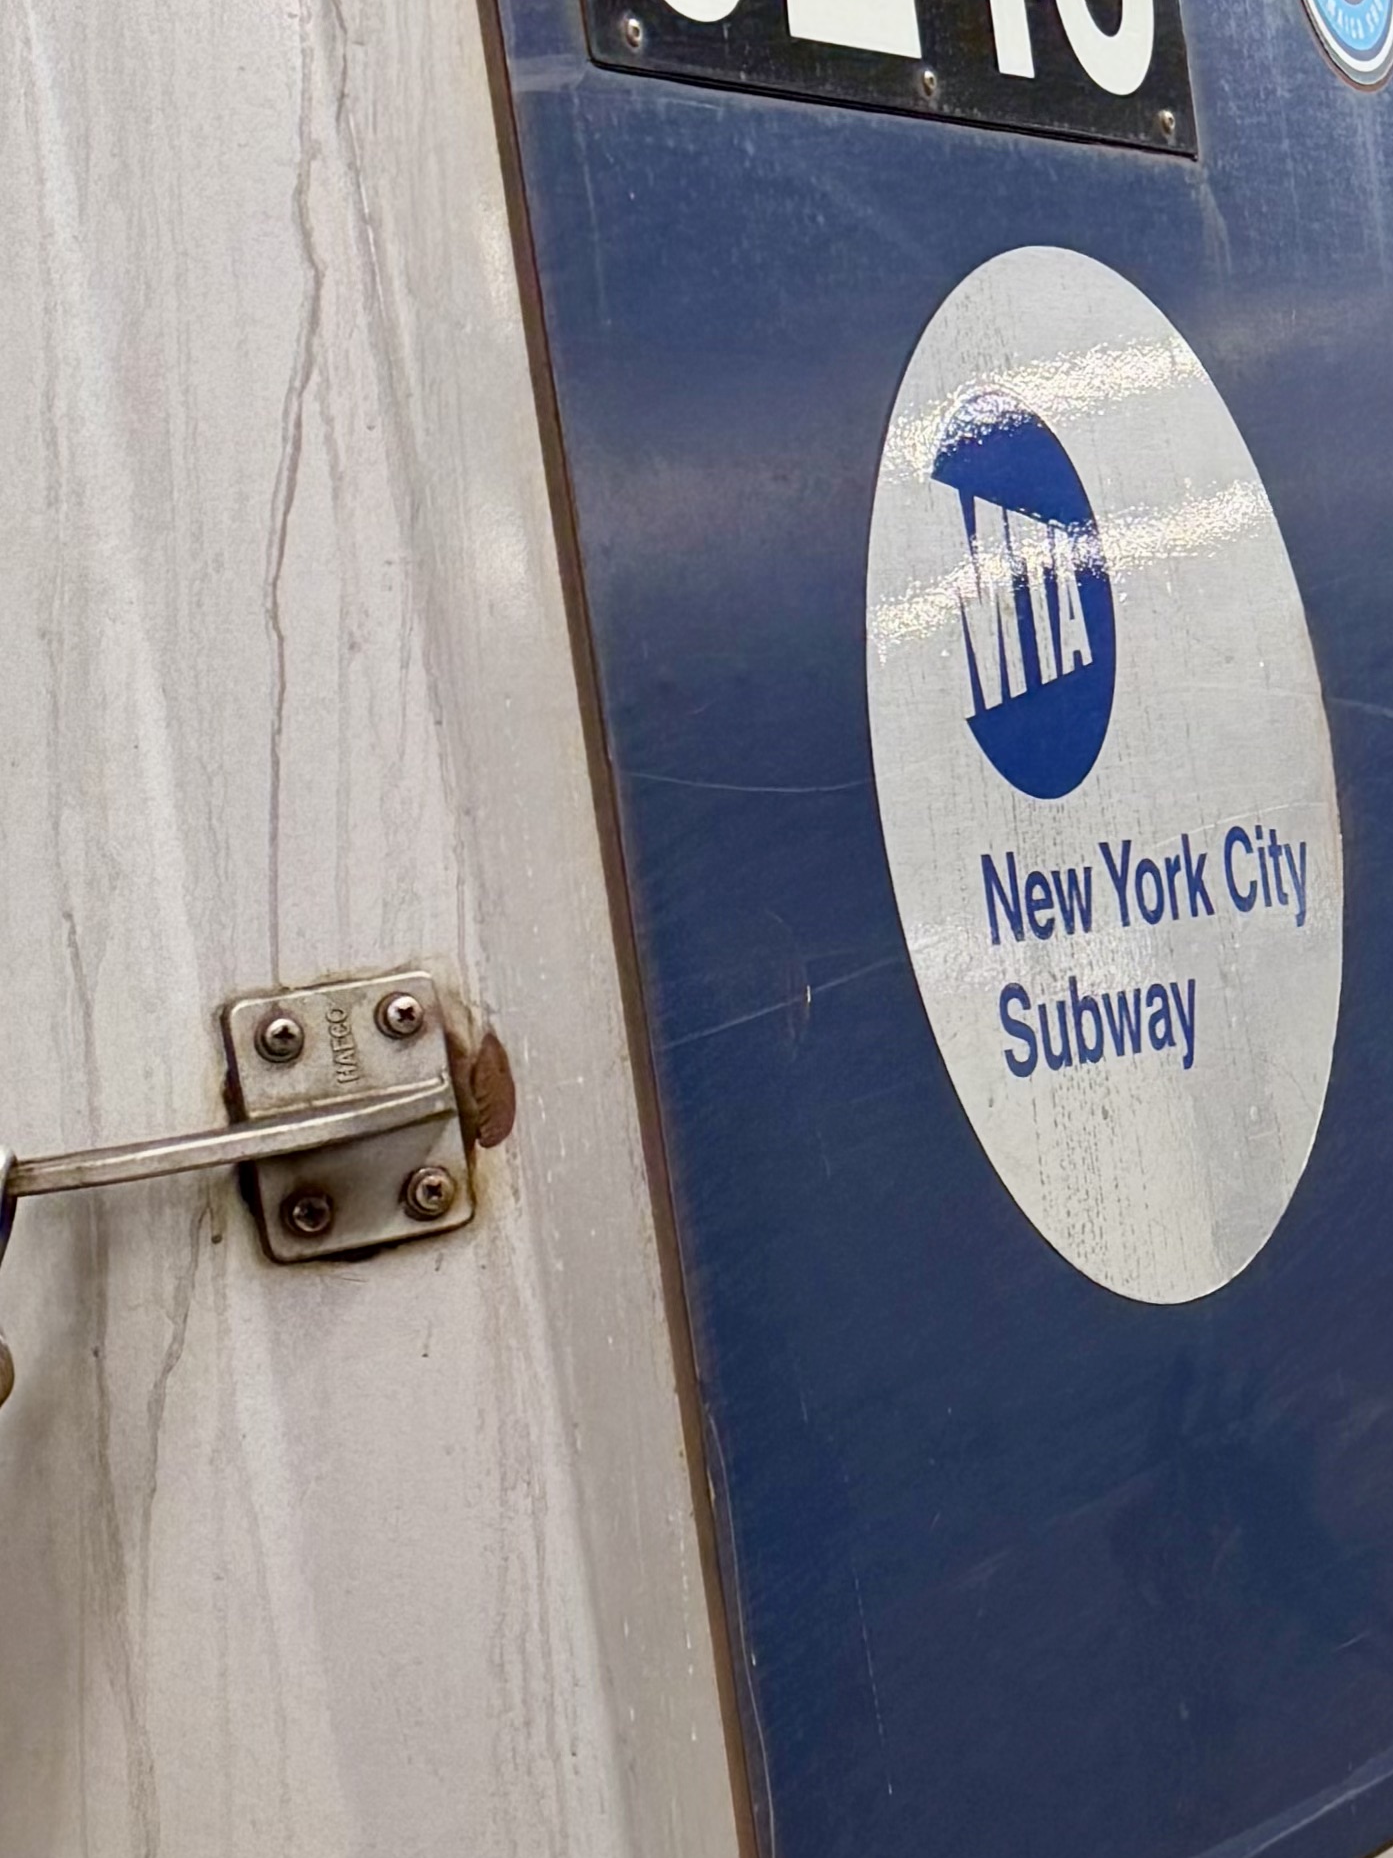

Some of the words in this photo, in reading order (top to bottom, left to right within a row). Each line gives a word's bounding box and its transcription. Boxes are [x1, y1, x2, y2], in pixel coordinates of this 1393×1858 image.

[955, 491, 1094, 721] MTA
[982, 851, 1092, 943] New
[1100, 832, 1215, 927] York
[1224, 825, 1308, 930] City
[1000, 981, 1195, 1078] Subway
